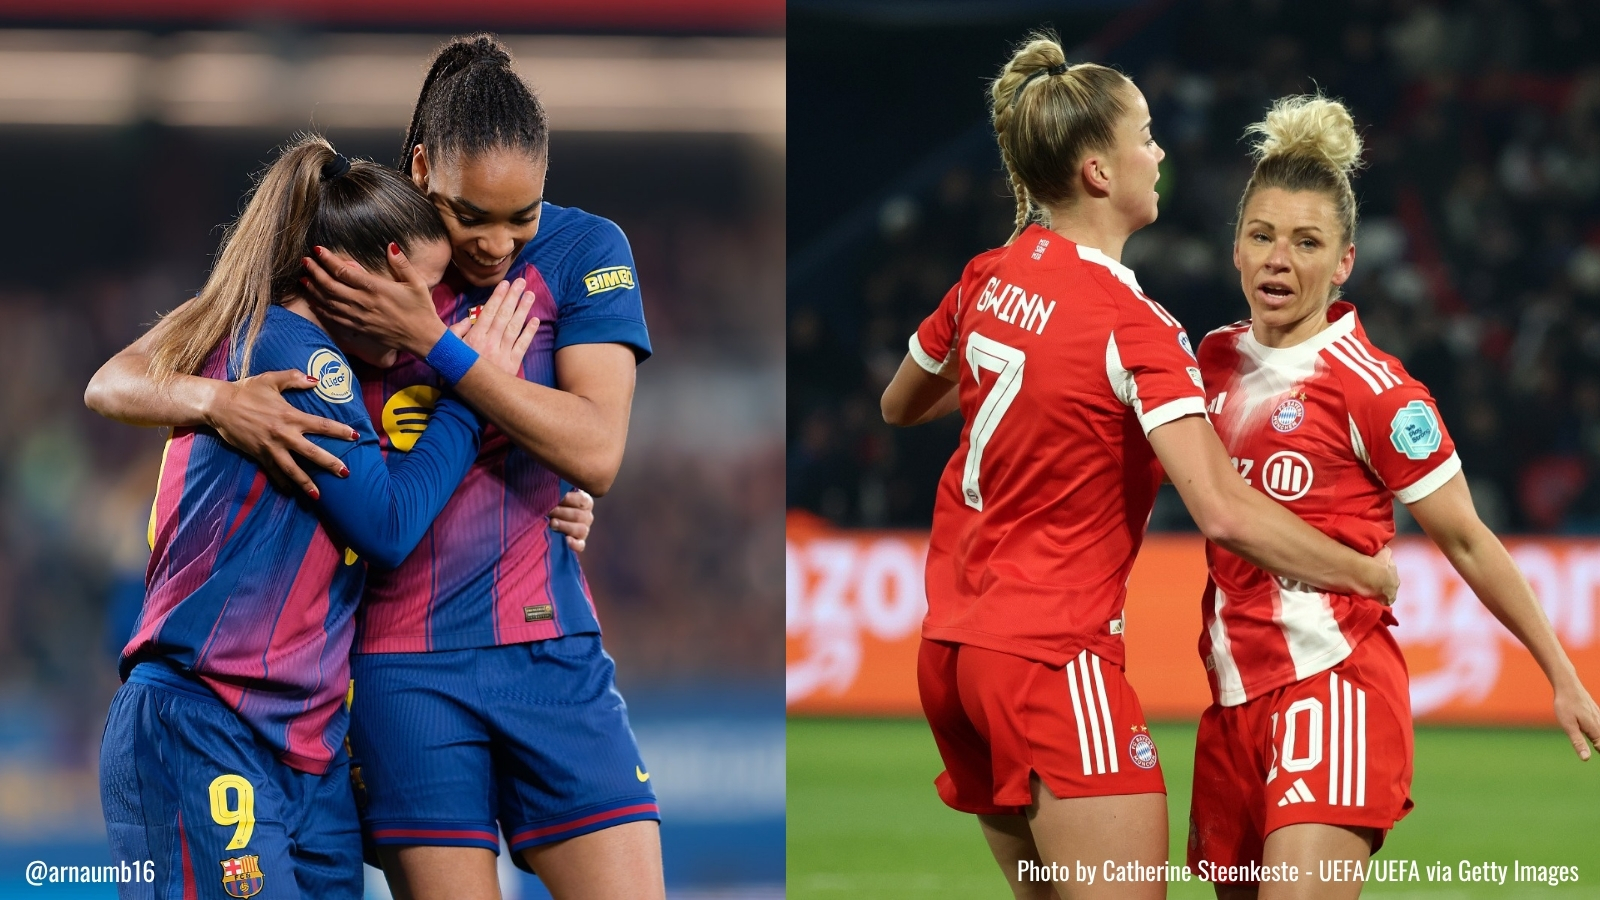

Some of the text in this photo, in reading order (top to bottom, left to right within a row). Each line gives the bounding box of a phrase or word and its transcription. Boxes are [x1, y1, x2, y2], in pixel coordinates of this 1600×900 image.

[585, 269, 634, 291] BIMBO
[976, 276, 1056, 335] GWINN
[962, 331, 1026, 512] 7
[208, 774, 255, 850] 9
